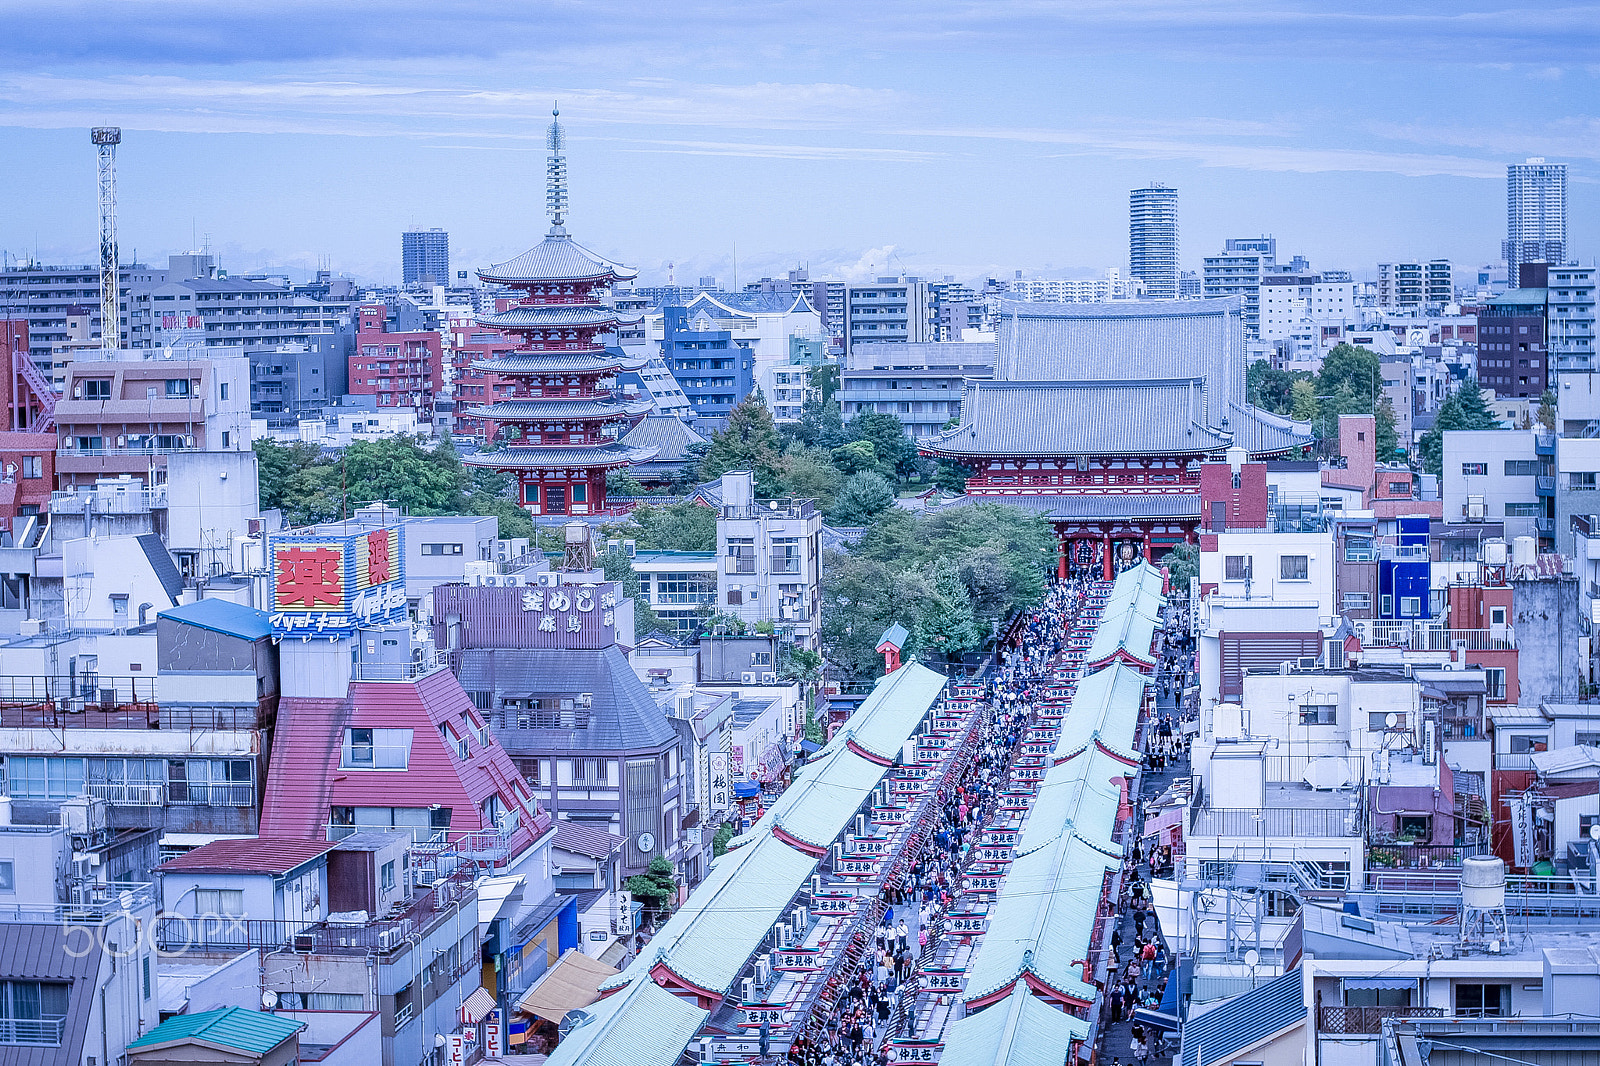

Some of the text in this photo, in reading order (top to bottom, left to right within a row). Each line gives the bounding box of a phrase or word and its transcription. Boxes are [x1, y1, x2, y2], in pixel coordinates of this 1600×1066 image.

[367, 529, 390, 585] 薬
[277, 547, 341, 607] 薬
[269, 612, 351, 632] マツモトキヨシ
[712, 773, 727, 805] 梅園
[487, 1025, 499, 1057] コーヒー
